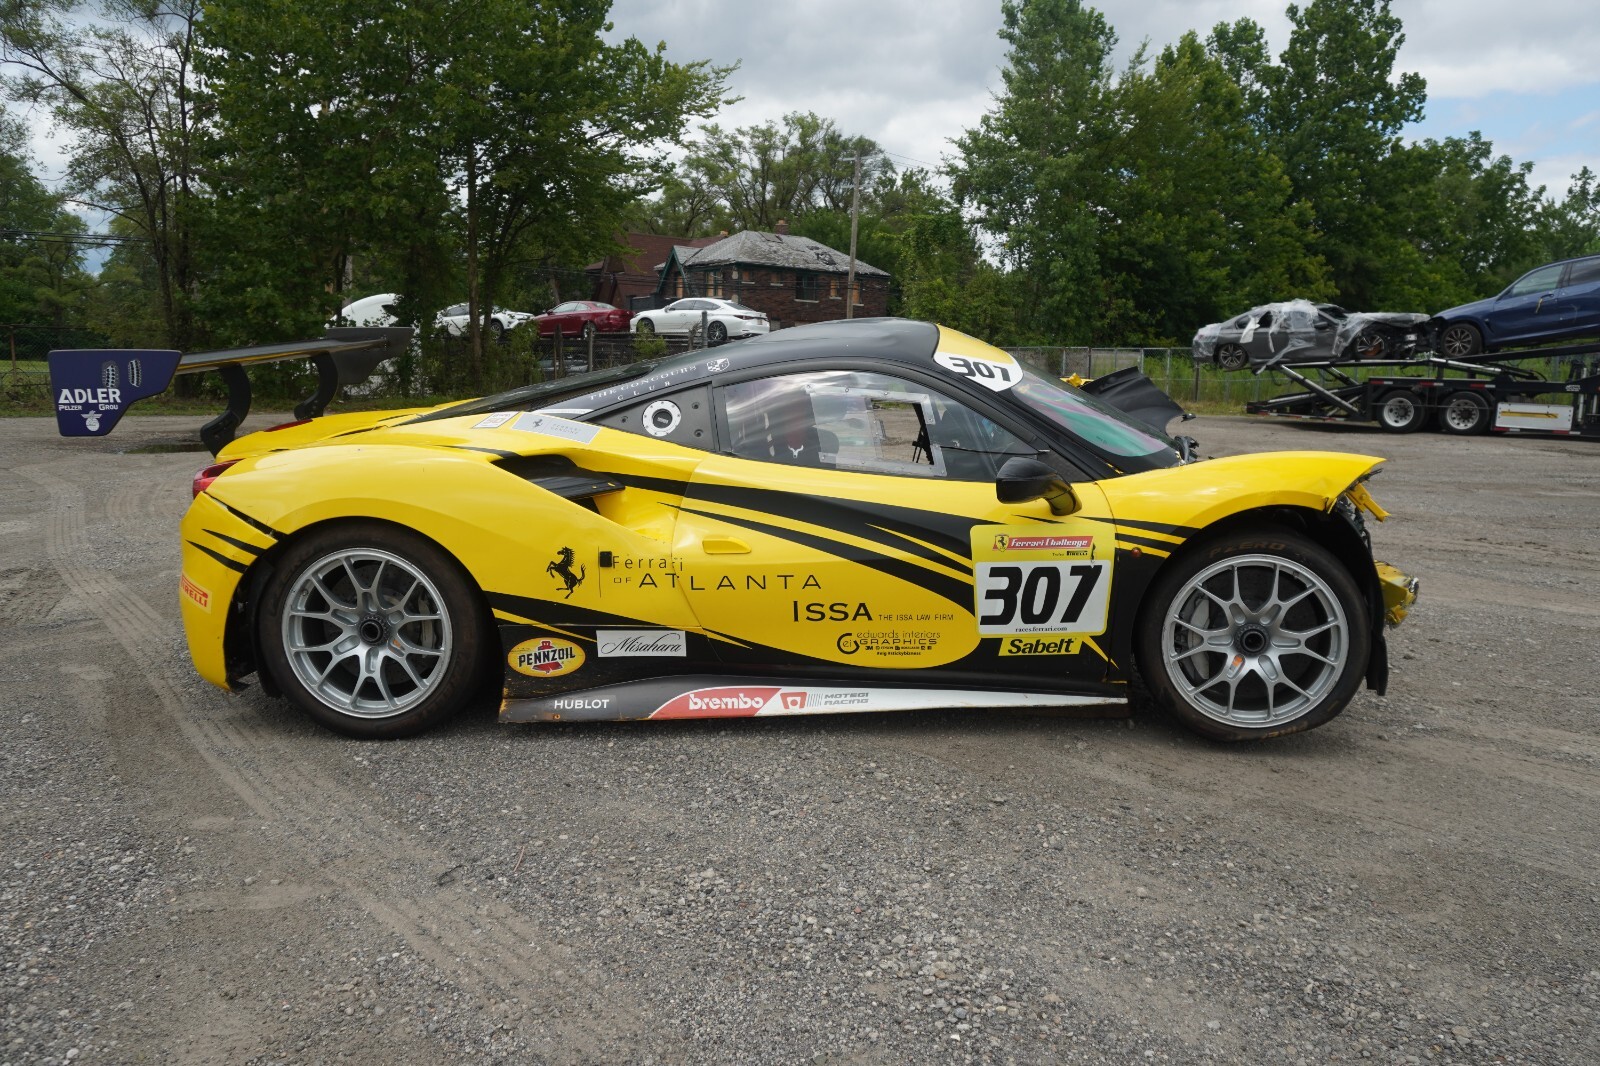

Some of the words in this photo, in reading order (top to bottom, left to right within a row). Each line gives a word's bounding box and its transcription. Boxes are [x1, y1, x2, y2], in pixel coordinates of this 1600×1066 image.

[948, 356, 1012, 382] 307
[58, 388, 121, 403] ADLER
[1011, 538, 1044, 548] Ferrari
[1045, 537, 1089, 548] Challenge
[638, 573, 822, 590] ATLANTA
[979, 565, 1103, 626] 307
[793, 600, 873, 622] ISSA
[856, 630, 899, 639] edwards
[902, 630, 941, 639] interiors
[601, 633, 682, 654] Misahara
[1008, 639, 1074, 654] Sabelt
[518, 646, 576, 667] PENNZOIL
[554, 699, 609, 709] HUBLOT
[688, 693, 764, 710] brembo
[823, 698, 869, 706] RACING
